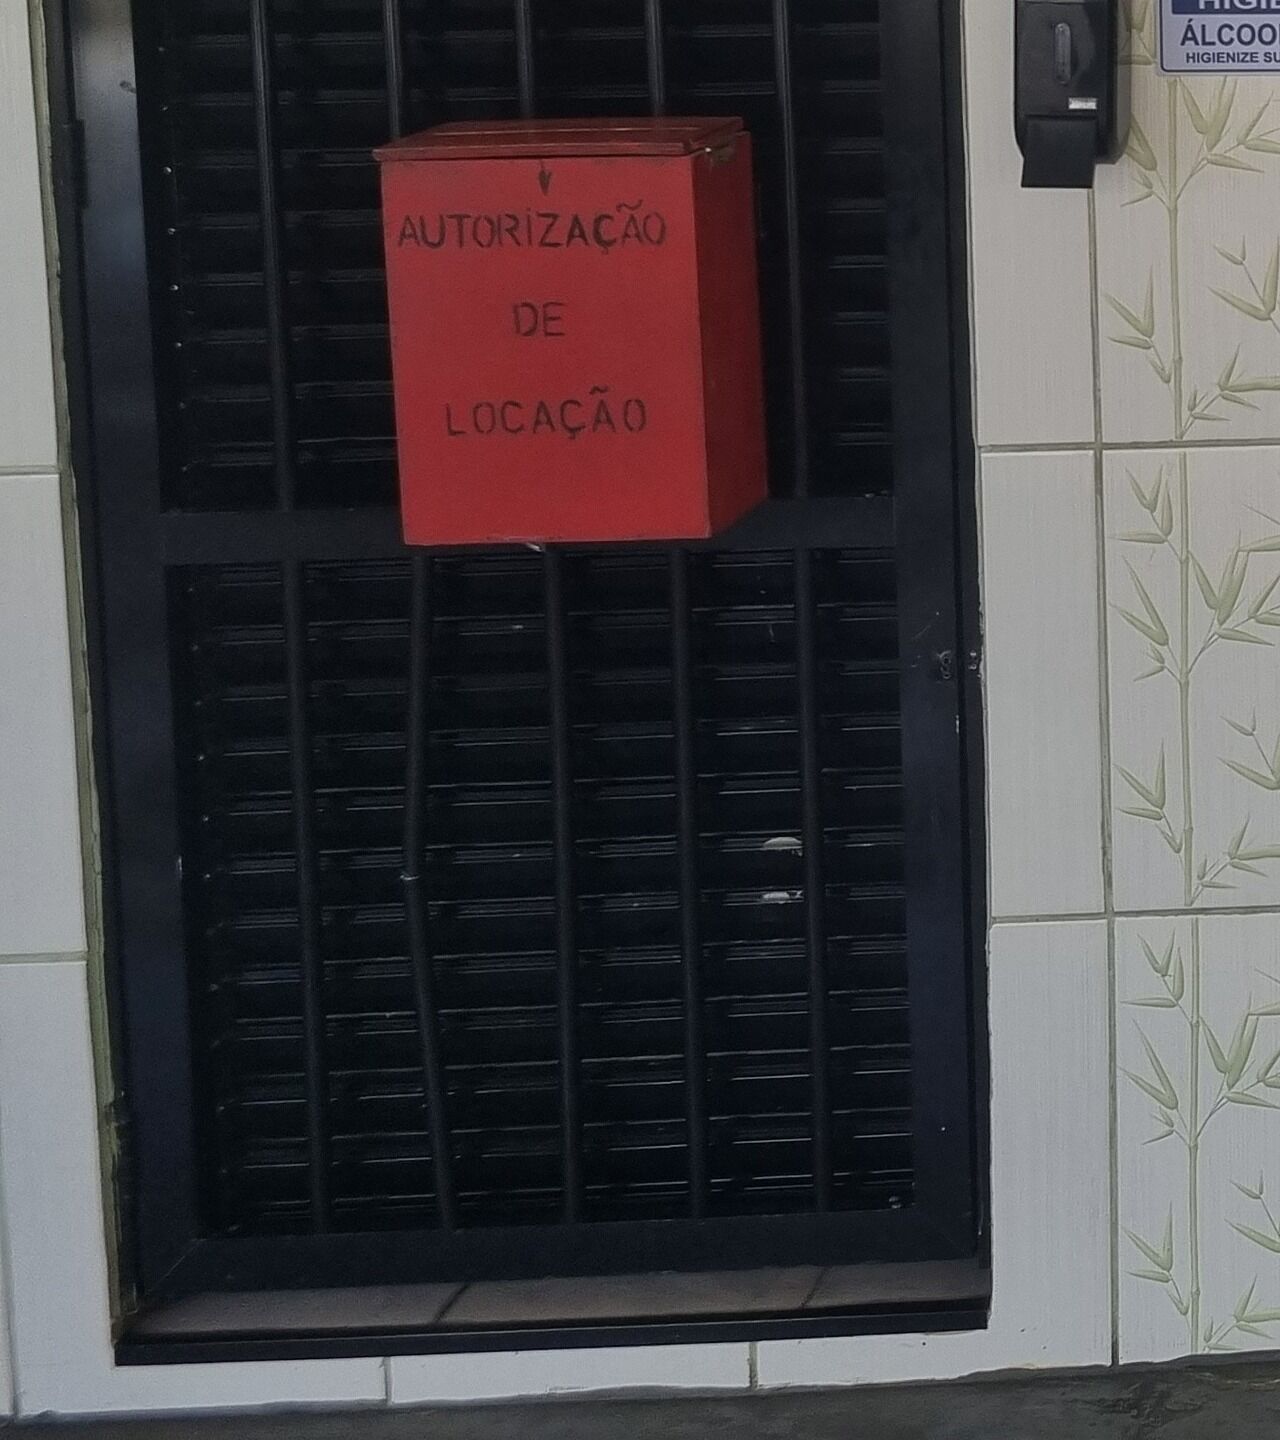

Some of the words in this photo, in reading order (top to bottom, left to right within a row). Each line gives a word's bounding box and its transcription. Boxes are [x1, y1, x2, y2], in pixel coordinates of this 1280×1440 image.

[1186, 52, 1259, 64] HIGIENIZE
[397, 200, 667, 255] AUTORIZAÇÃO
[513, 302, 566, 337] DE
[445, 386, 647, 439] LOCAÇÃO
